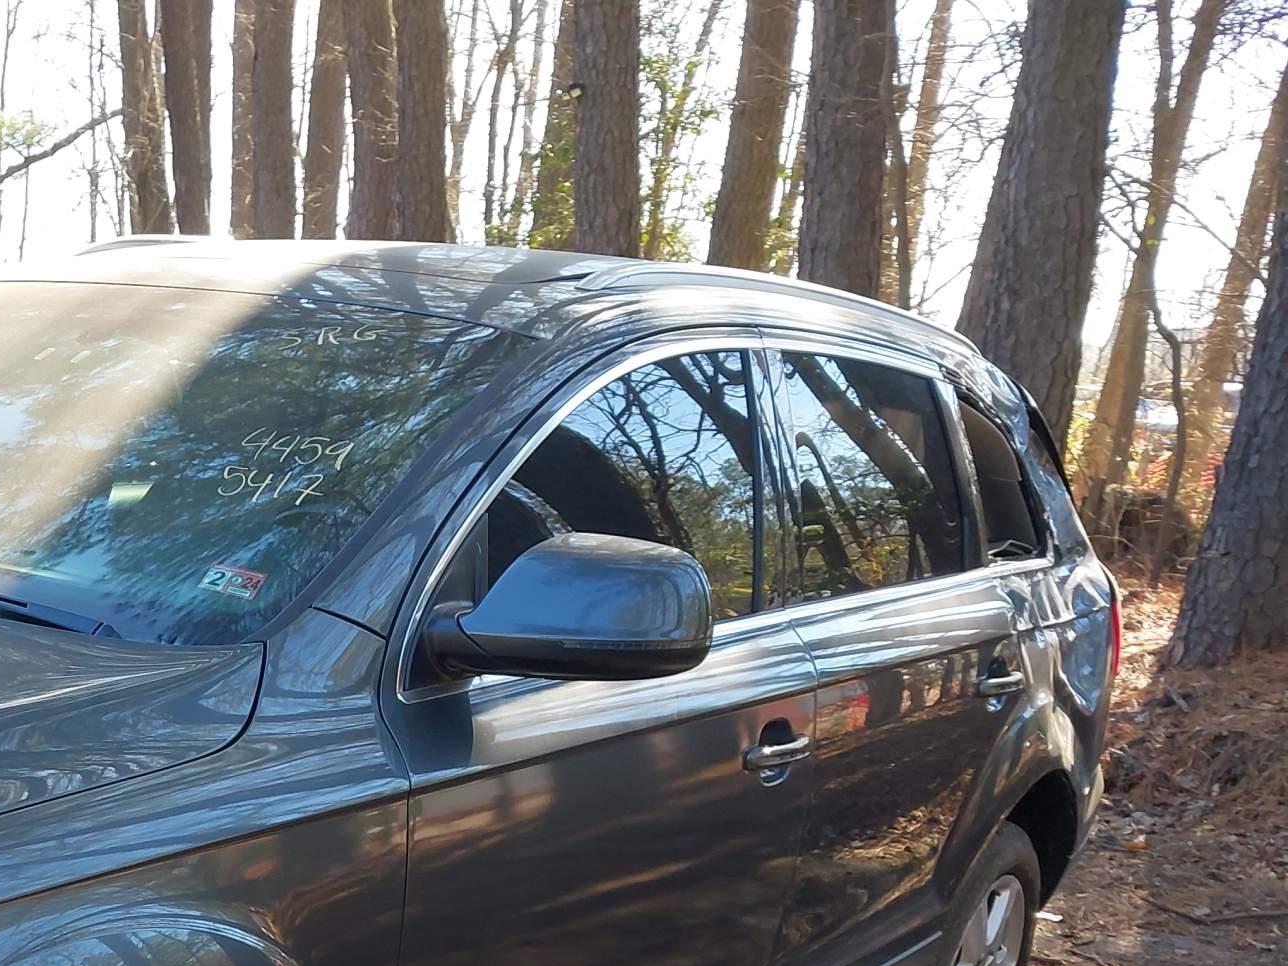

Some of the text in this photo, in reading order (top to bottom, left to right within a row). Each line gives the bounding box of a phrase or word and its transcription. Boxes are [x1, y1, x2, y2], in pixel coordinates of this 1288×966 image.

[241, 427, 355, 471] 4459
[217, 465, 324, 506] 5417
[206, 571, 226, 587] 2
